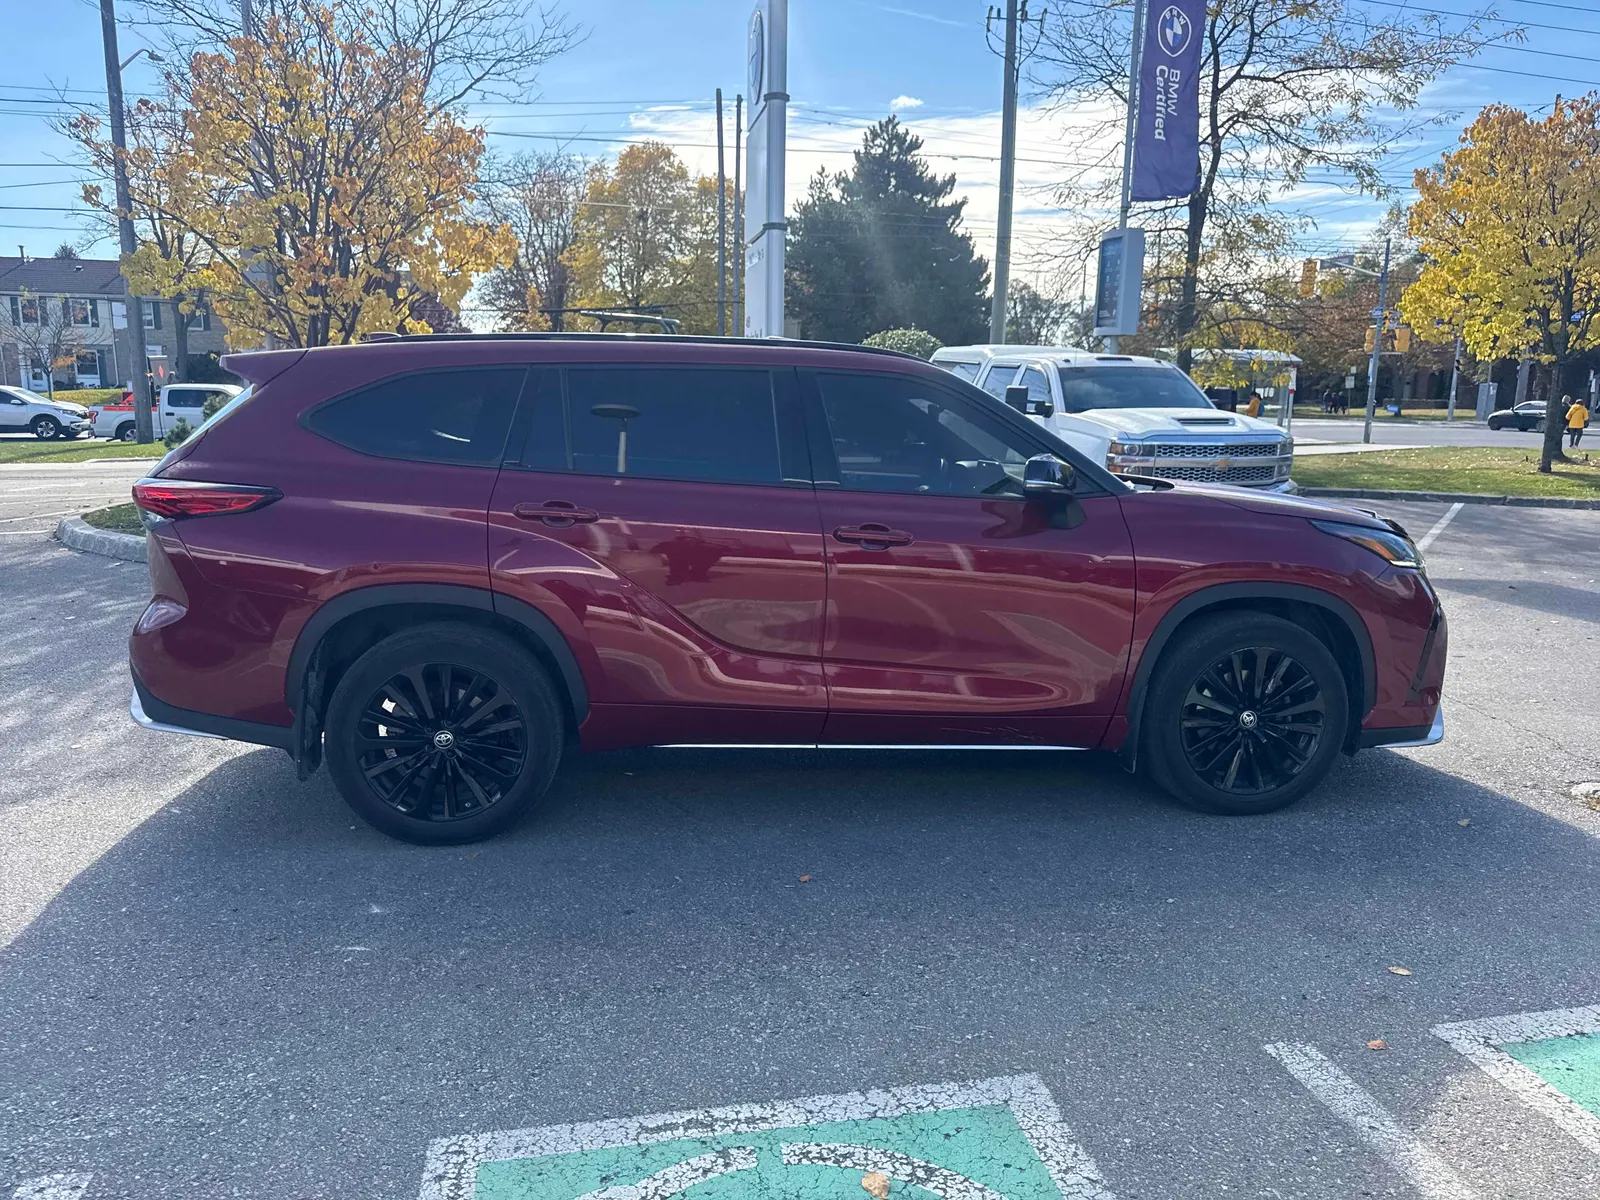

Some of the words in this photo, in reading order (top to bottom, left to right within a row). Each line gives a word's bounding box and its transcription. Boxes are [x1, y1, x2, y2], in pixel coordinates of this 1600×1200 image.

[1165, 8, 1186, 25] BMW
[1154, 65, 1169, 141] Certified
[1167, 68, 1180, 116] BMW
